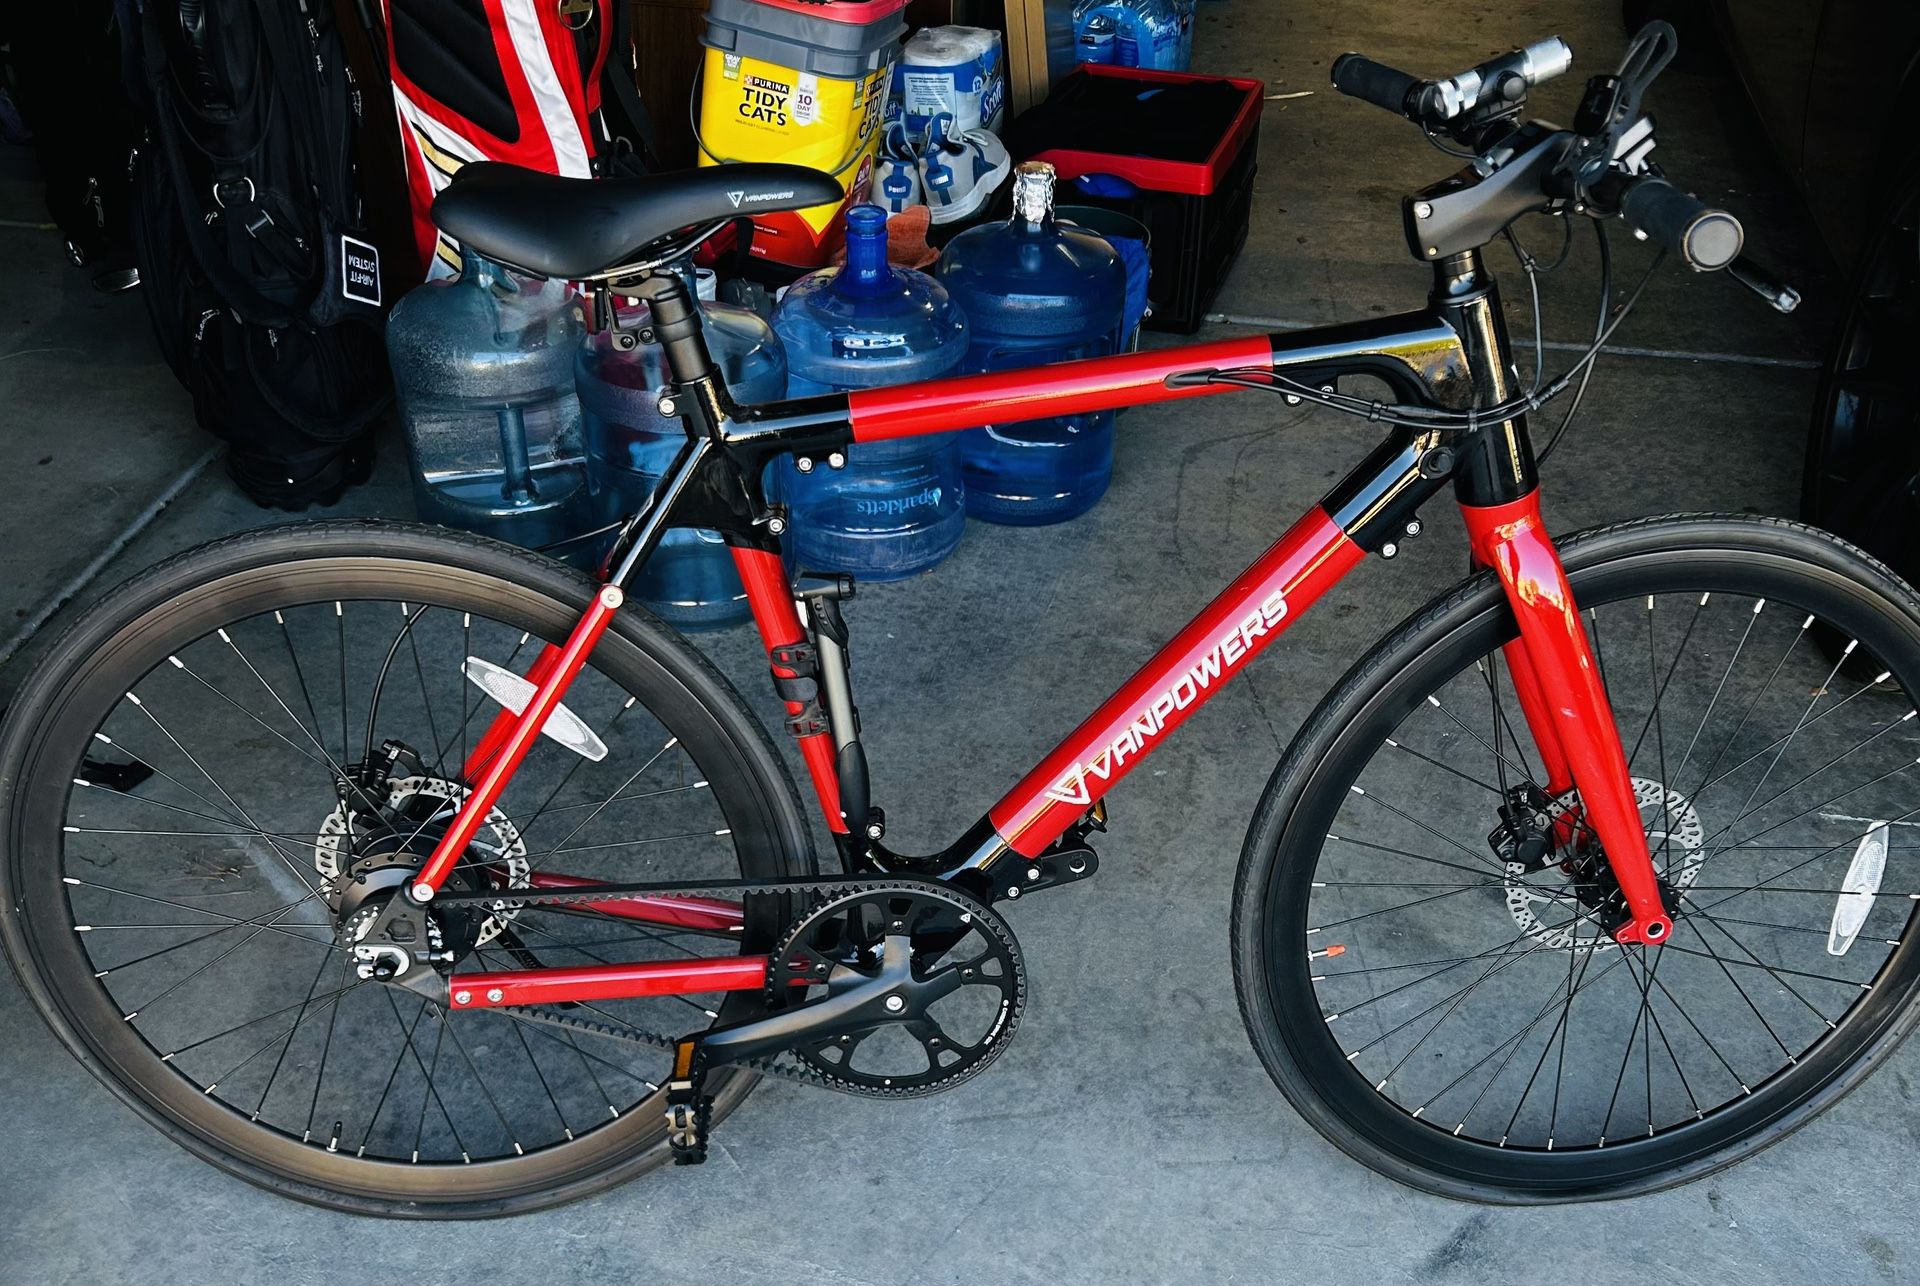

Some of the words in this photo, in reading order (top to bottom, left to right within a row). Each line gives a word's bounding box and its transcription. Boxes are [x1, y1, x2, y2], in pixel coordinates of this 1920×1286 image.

[754, 78, 788, 93] PURINA
[742, 87, 788, 110] TIDY
[798, 94, 812, 106] 10
[739, 103, 787, 126] CATS
[797, 104, 811, 112] DAY
[885, 102, 897, 118] ott
[745, 191, 794, 202] VANPOWERS
[348, 254, 375, 273] SYSTEM
[350, 271, 374, 287] AIR-FIT
[857, 487, 936, 516] Sparkletts
[1087, 590, 1289, 780] VANPOWERS
